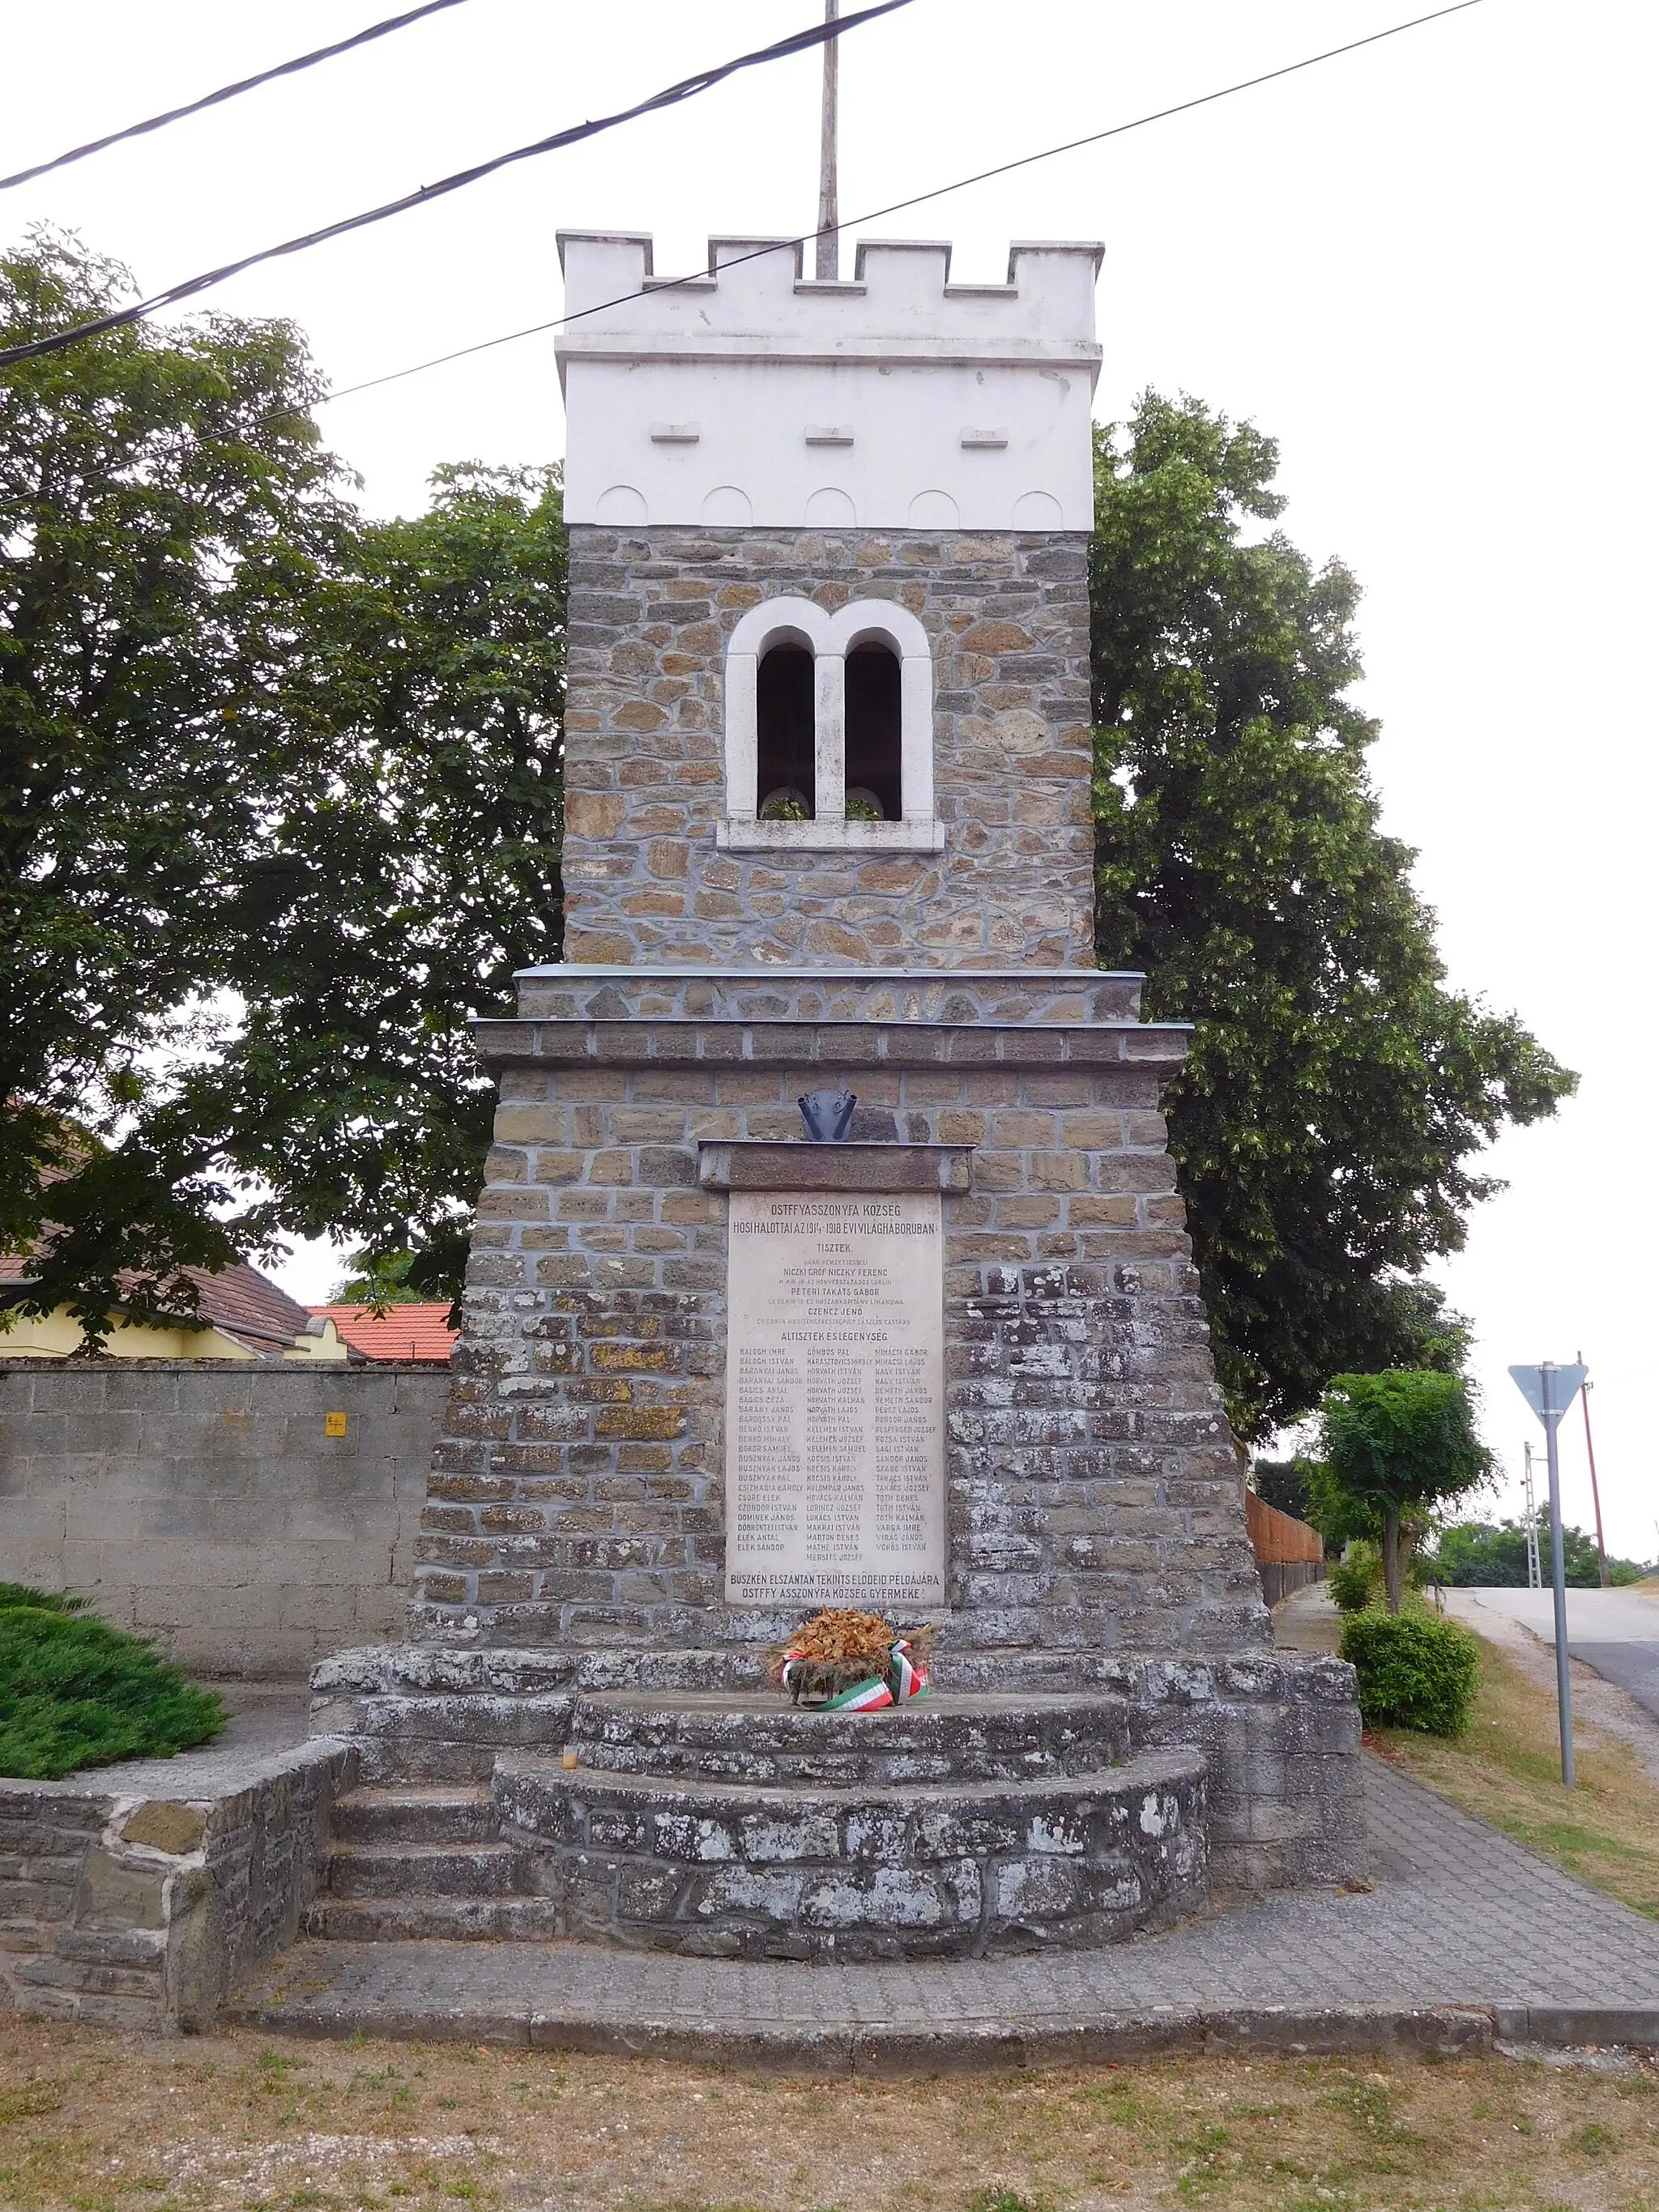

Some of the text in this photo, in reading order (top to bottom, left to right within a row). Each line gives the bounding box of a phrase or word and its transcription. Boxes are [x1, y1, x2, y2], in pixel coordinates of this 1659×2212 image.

[753, 1222, 793, 1234] HALOTTAI
[792, 1222, 805, 1234] AZ
[806, 1222, 842, 1234] 1914-1918
[828, 1268, 856, 1276] NICZKY
[858, 1268, 888, 1276] FERENC
[781, 1332, 825, 1341] ALTISZTEK
[739, 1348, 787, 1356] BALOGH IMRE
[806, 1435, 838, 1443] KELEMEN
[738, 1445, 761, 1453] BOKOR
[806, 1445, 838, 1453] KELEMEN
[806, 1455, 830, 1463] KOCSIS
[778, 1464, 801, 1473] LAJOS
[806, 1464, 830, 1473] KOCSIS
[806, 1474, 831, 1482] KOCSIS
[762, 1494, 781, 1502] ELEK
[876, 1524, 921, 1532] VARGA IMRE
[806, 1554, 838, 1562] MERSITS
[816, 1575, 851, 1585] TEKINTS
[742, 1588, 777, 1599] OSTFFY
[779, 1588, 831, 1599] ASSZONYFA
